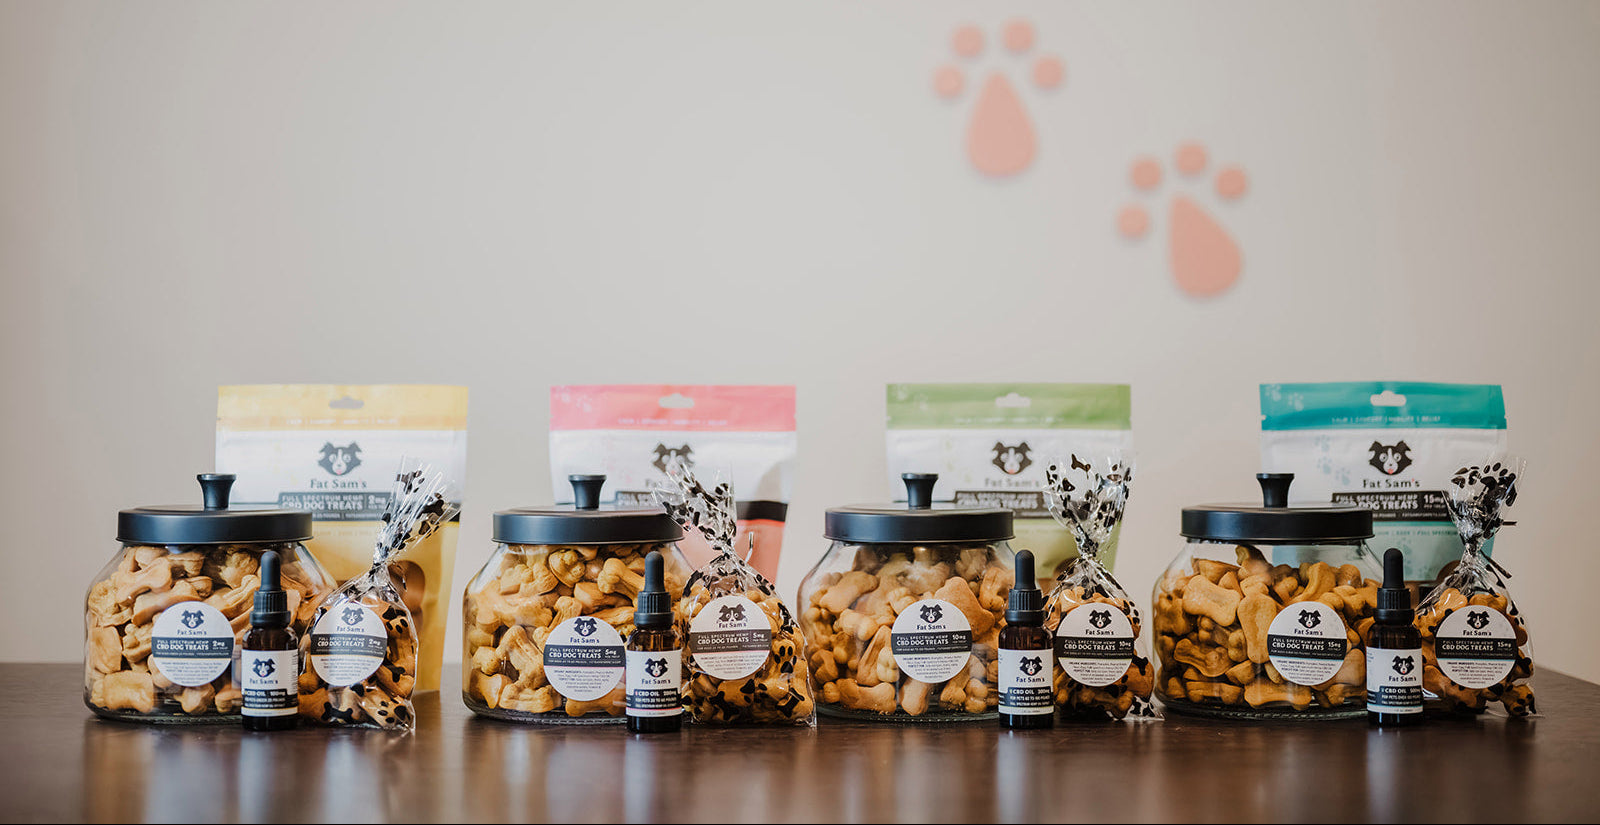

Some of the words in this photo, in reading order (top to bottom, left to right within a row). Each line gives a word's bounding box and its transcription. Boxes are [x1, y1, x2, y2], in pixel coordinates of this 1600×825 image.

[310, 479, 328, 489] Fat
[332, 479, 367, 489] Sam's
[1363, 479, 1381, 488] Fat
[1385, 478, 1420, 488] Sam's
[325, 501, 363, 510] TREATS
[1382, 501, 1418, 510] TREATS
[342, 640, 365, 648] TREATS
[570, 636, 580, 644] Fat
[726, 636, 749, 644] TREATS
[1301, 643, 1324, 651] TREATS
